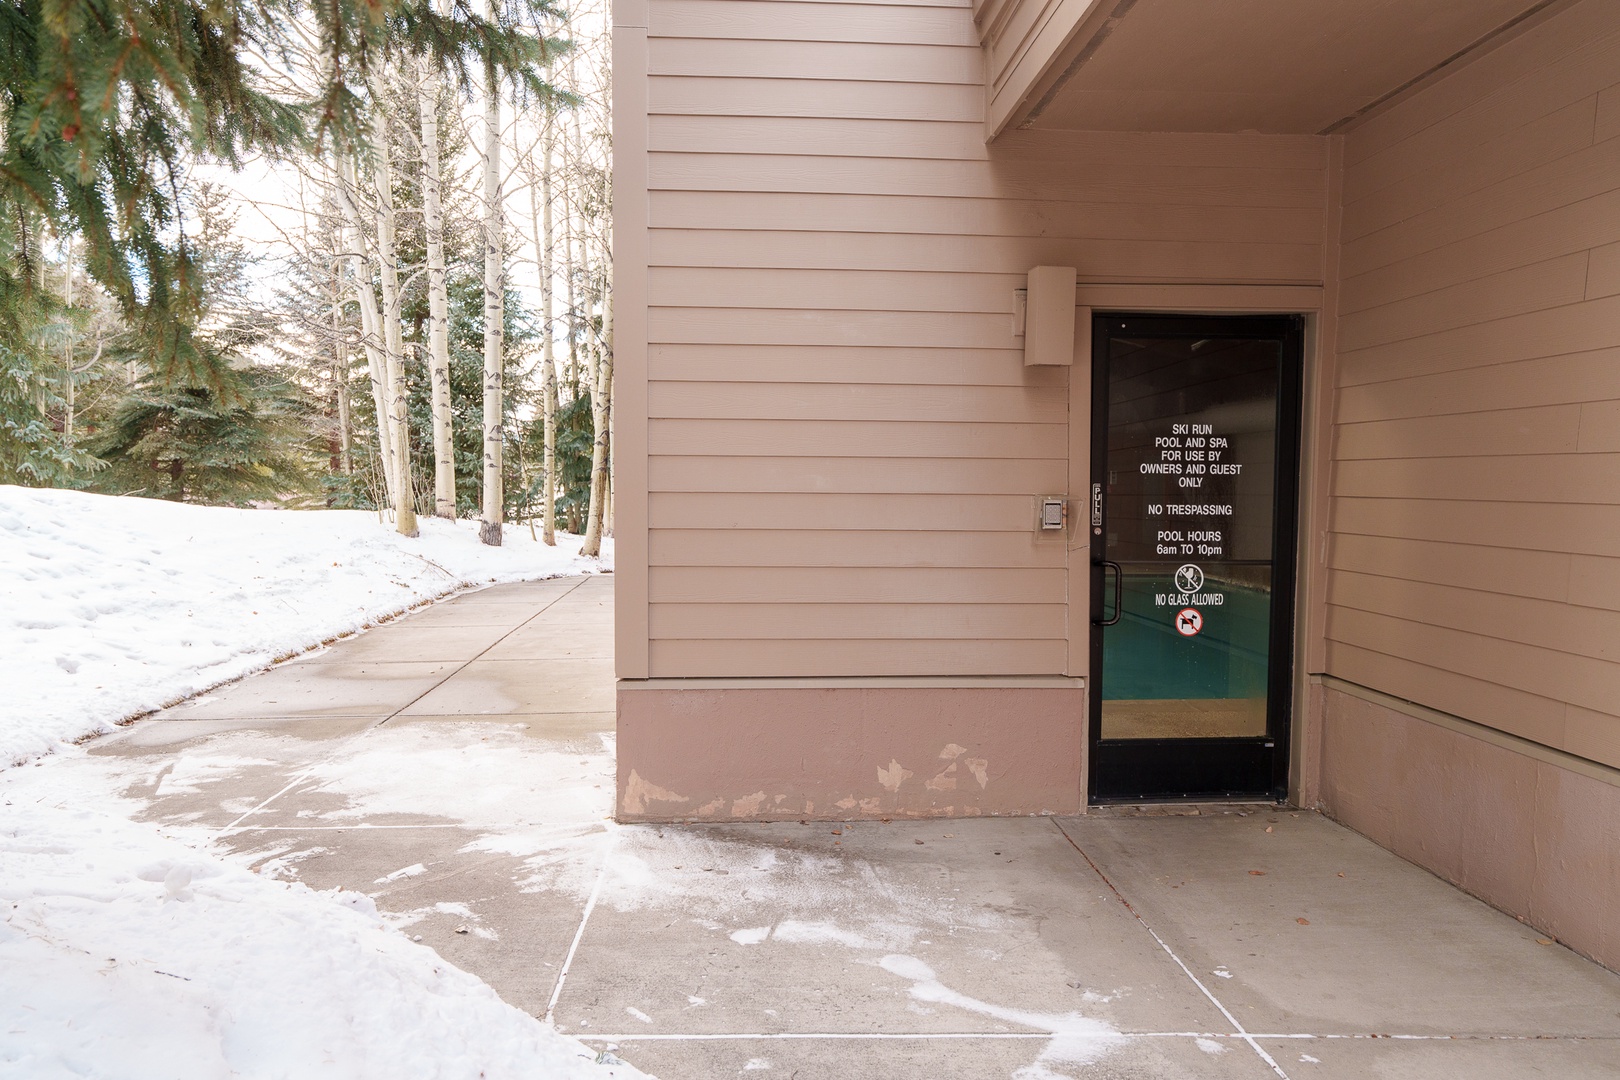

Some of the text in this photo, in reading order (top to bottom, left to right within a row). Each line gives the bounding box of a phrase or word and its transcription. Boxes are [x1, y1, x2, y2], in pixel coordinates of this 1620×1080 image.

[1173, 424, 1212, 434] SKI RUN
[1156, 437, 1227, 448] POOL AND SPA
[1162, 451, 1221, 461] FOR USE BY
[1140, 464, 1242, 474] OWNERS AND GUEST
[1179, 477, 1203, 487] ONLY
[1149, 505, 1232, 515] NO TRESPASSING
[1158, 531, 1221, 541] POOL HOURS
[1157, 544, 1221, 556] 6am TO 10pm
[1156, 594, 1223, 605] NO GLASS ALLOWED
